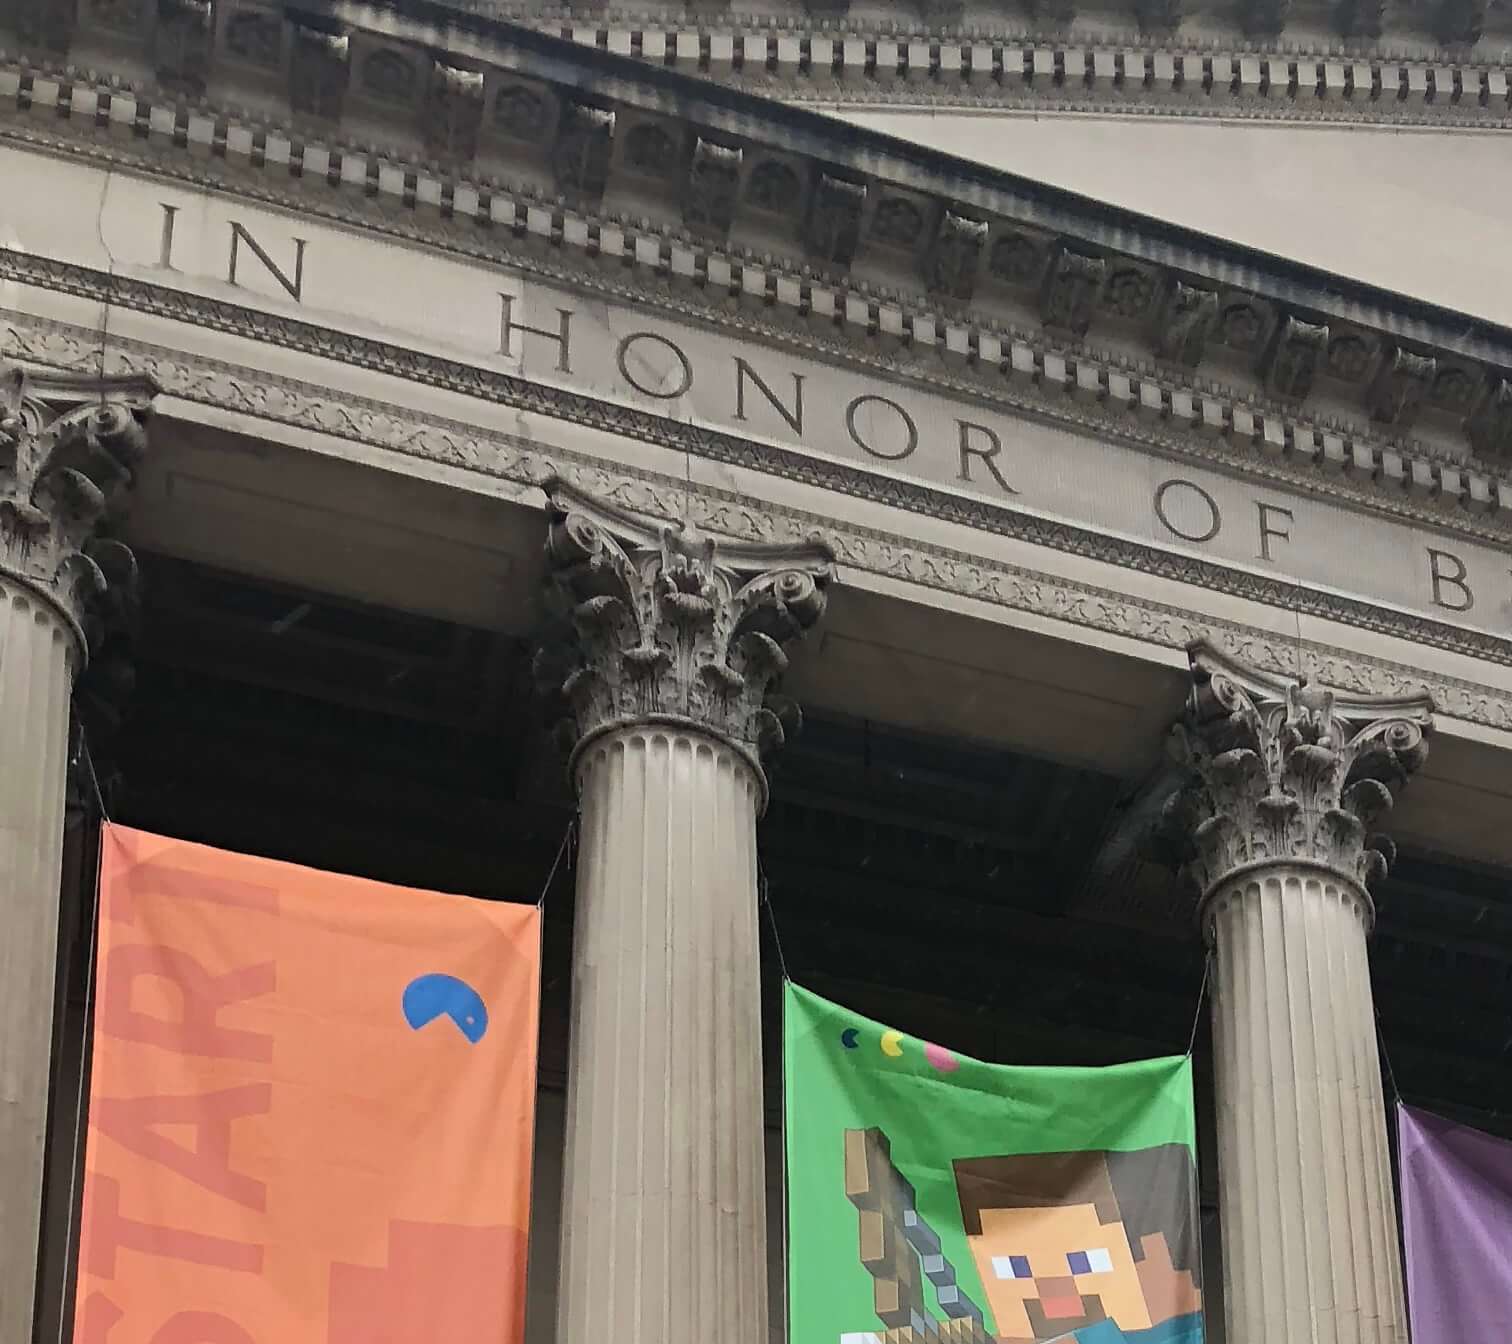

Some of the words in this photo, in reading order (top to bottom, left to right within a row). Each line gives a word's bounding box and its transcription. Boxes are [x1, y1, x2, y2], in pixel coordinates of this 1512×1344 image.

[158, 202, 307, 302] IN
[498, 292, 1022, 495] HONOR
[1153, 478, 1294, 561] OF
